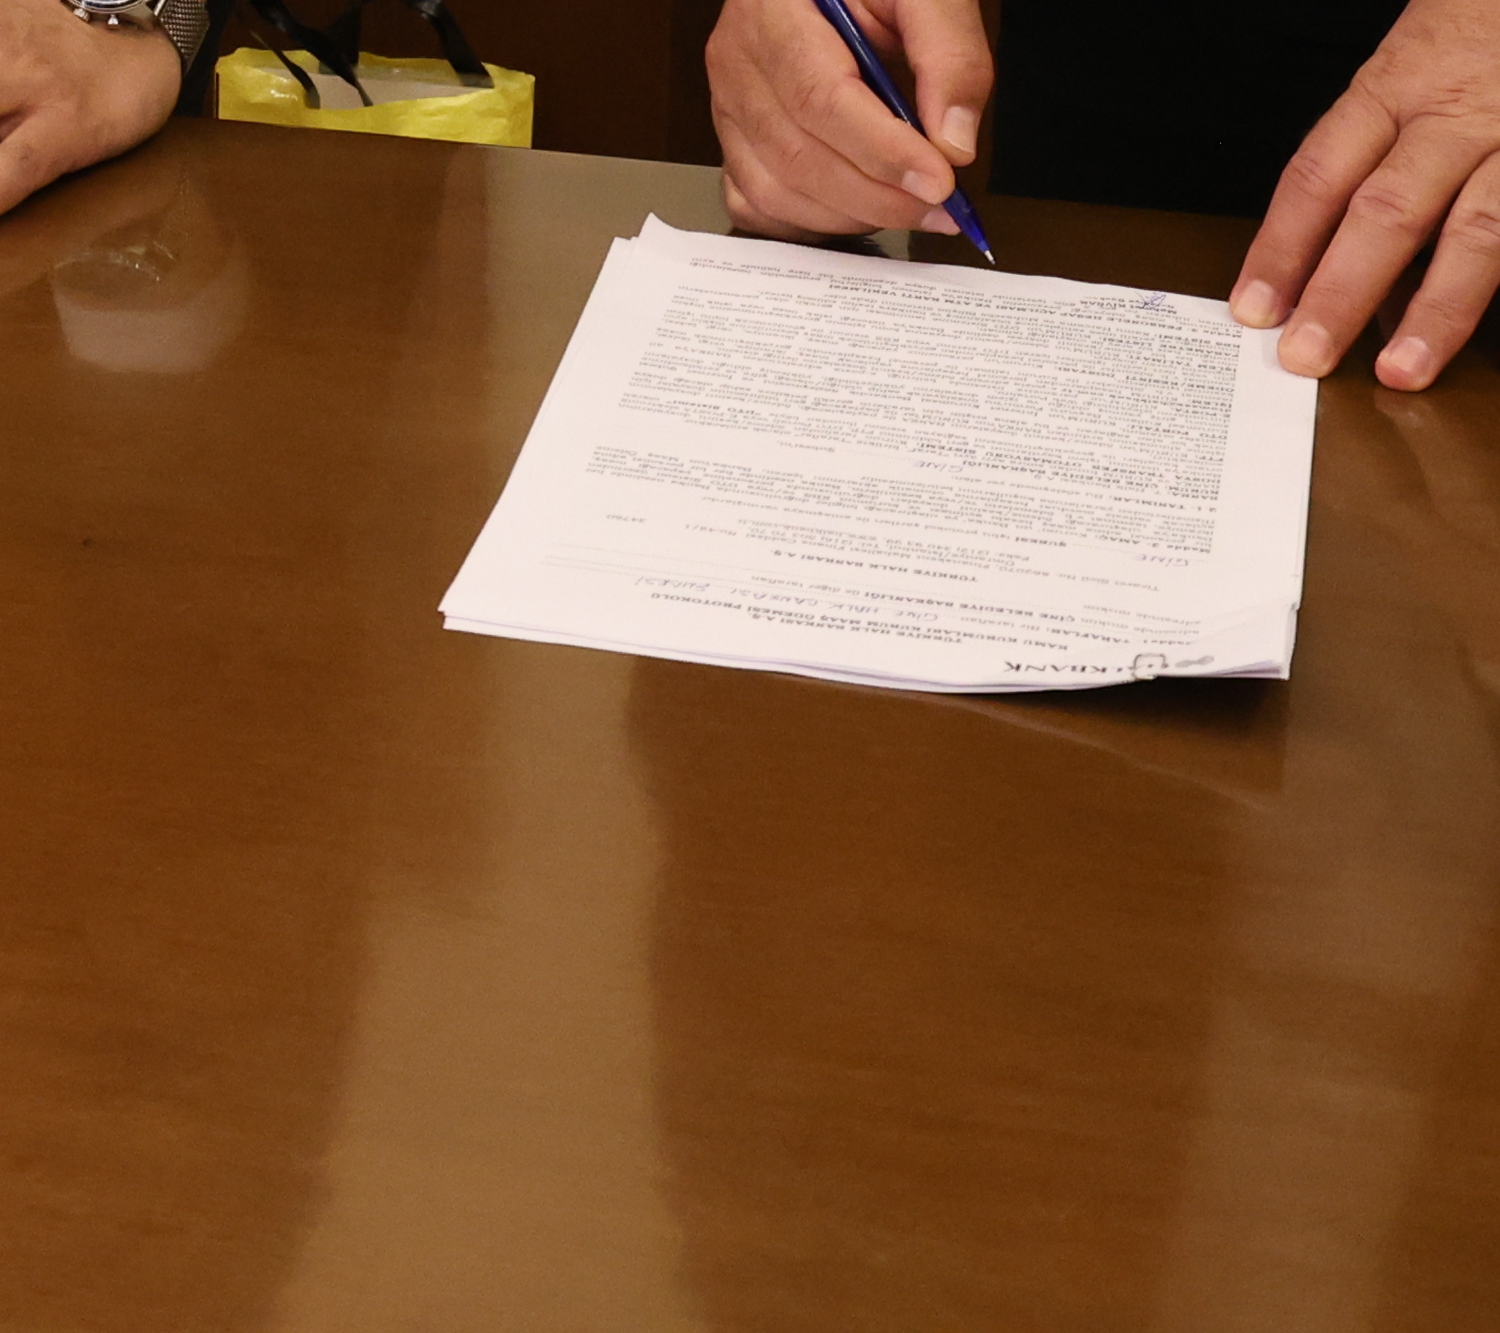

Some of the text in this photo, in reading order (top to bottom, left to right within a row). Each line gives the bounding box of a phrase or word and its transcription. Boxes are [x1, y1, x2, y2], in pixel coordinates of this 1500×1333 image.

[799, 553, 864, 567] BANKASI
[867, 562, 908, 573] HALK
[911, 568, 979, 582] TÜRKİYE
[863, 590, 954, 608] BAŞKANLIĞI
[745, 604, 815, 620] ÖDEMESİ
[958, 602, 1033, 618] BELEDİYE
[778, 616, 845, 630] BANKASI
[848, 624, 890, 636] HALK
[864, 619, 920, 632] KURUM
[894, 629, 962, 645] TÜRKİYE
[925, 626, 1017, 644] KURUMLARI
[1022, 638, 1068, 650] KAMU
